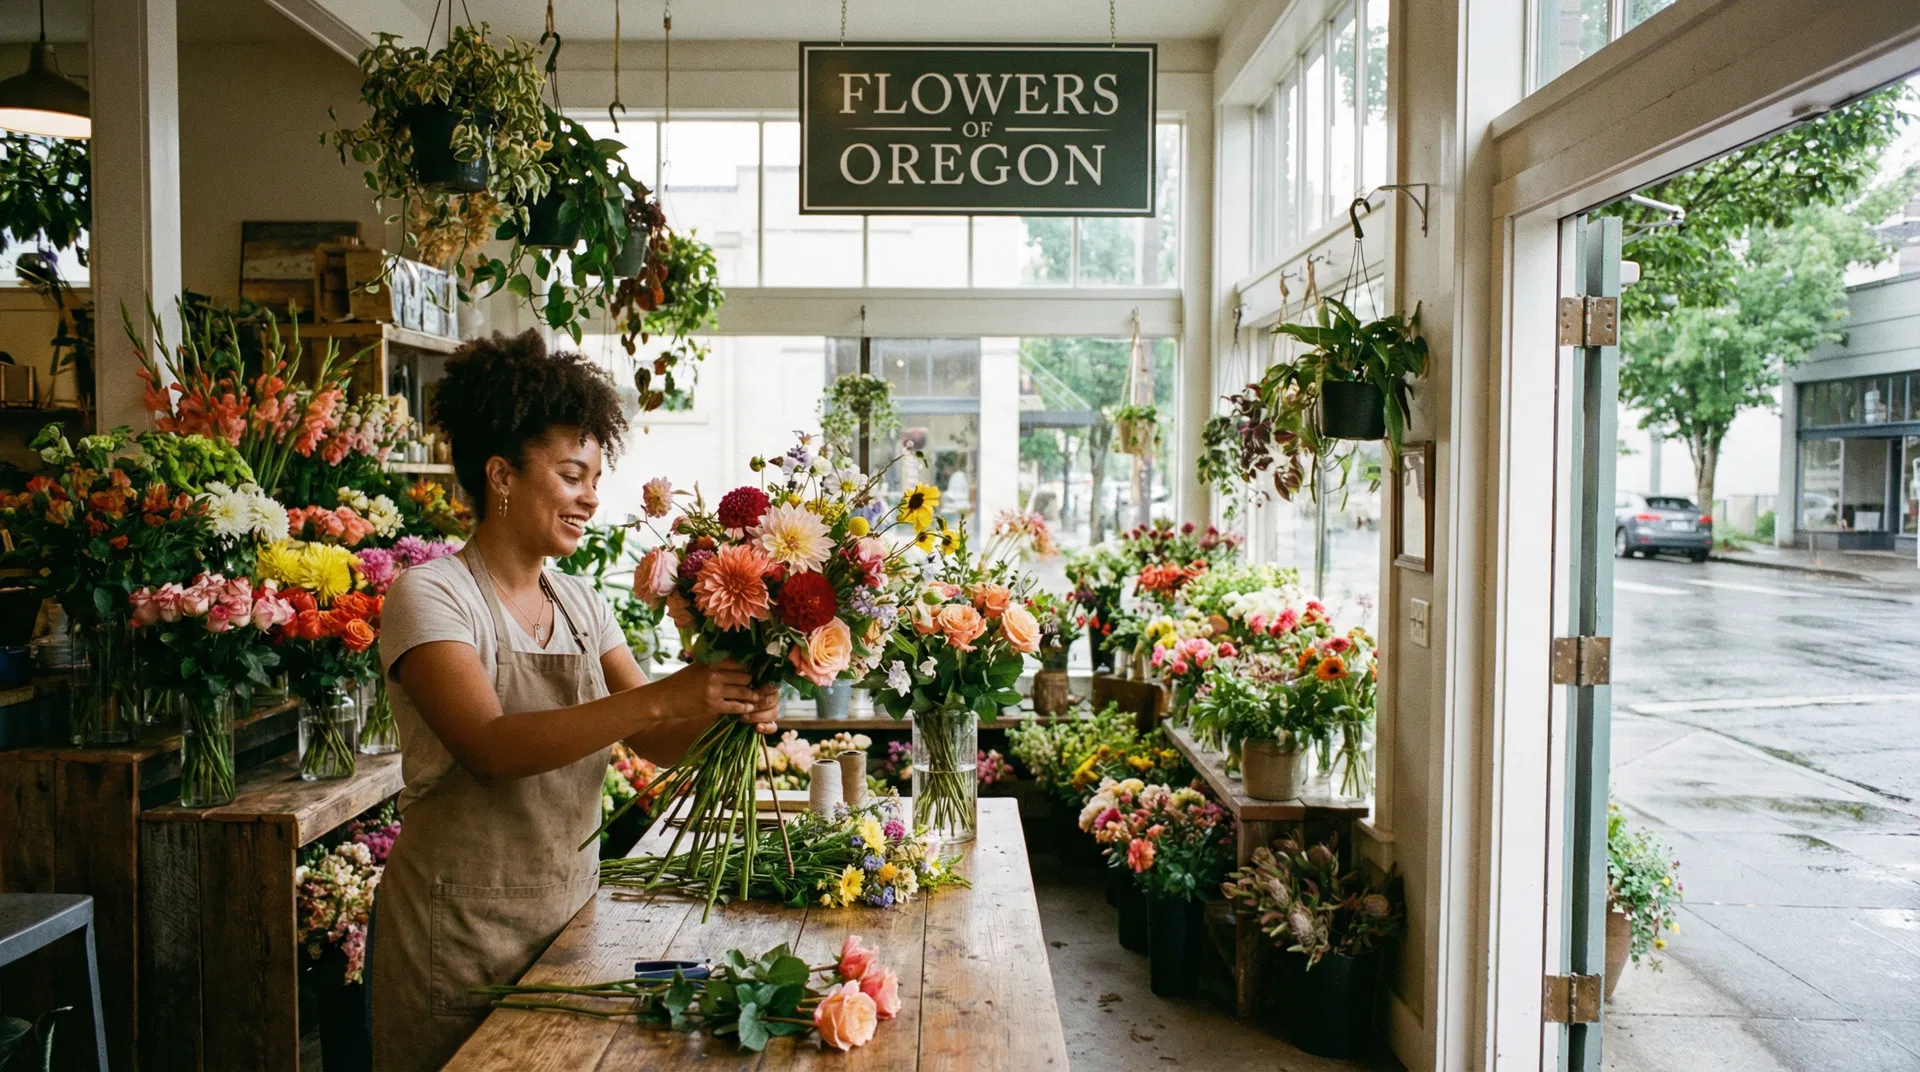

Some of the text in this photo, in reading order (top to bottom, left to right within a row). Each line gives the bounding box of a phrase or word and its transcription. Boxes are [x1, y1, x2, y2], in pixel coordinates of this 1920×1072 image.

[838, 73, 1119, 115] FLOWERS
[962, 121, 993, 138] OF
[840, 143, 1106, 186] OREGON
